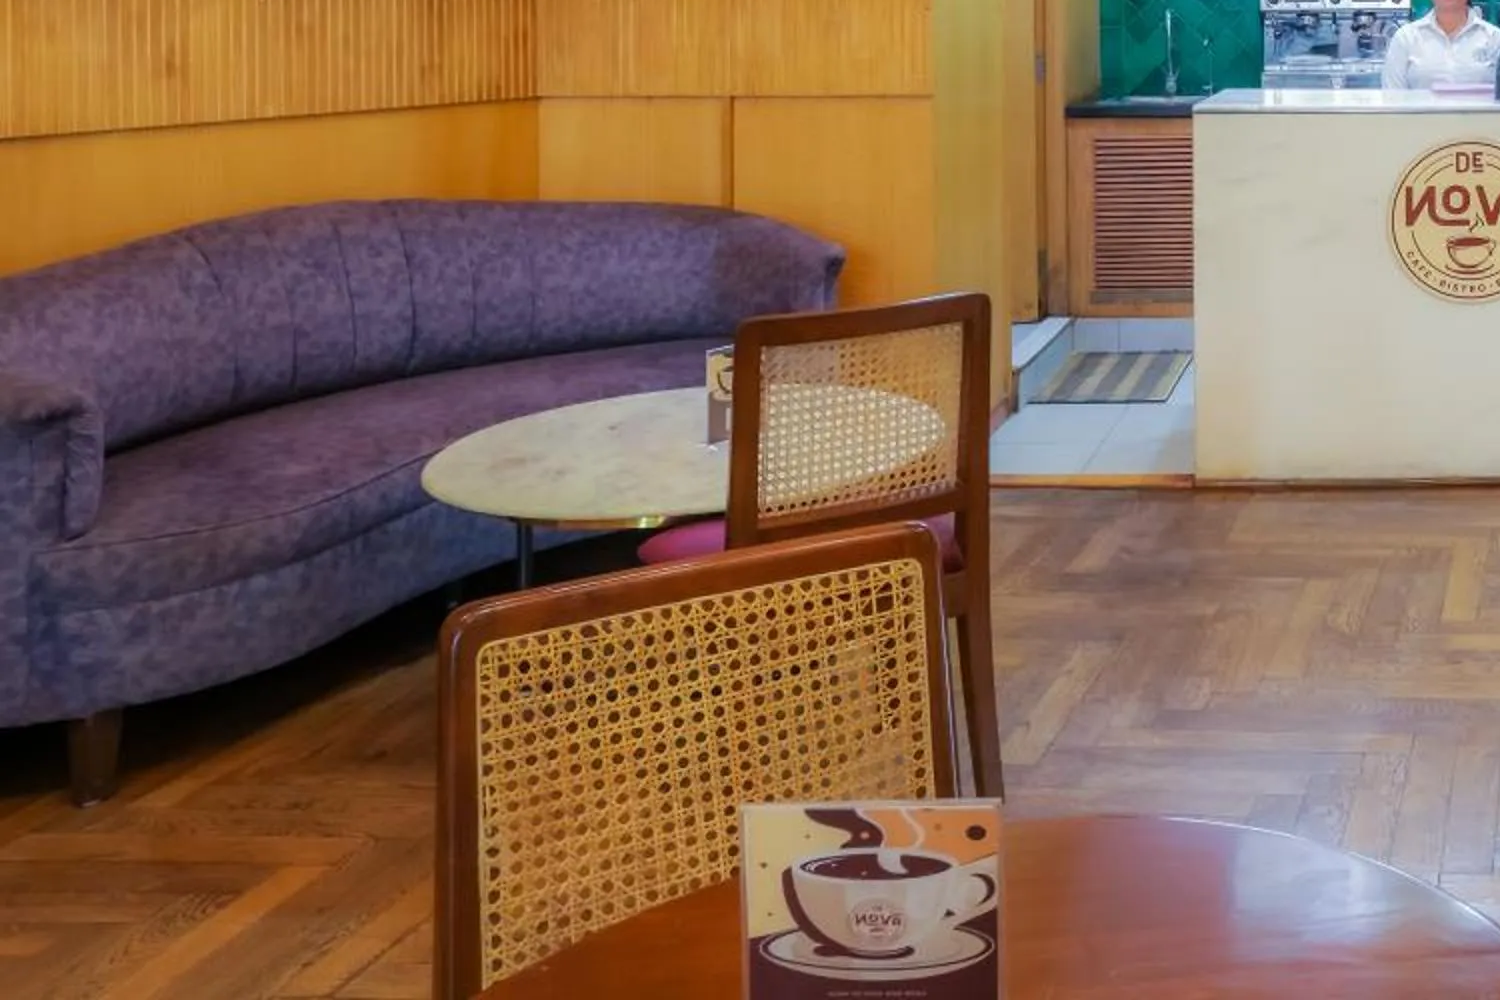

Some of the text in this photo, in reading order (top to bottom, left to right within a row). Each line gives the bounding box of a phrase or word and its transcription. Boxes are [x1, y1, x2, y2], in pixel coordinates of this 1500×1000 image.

[1455, 152, 1484, 173] DE
[1439, 280, 1487, 293] BISTRO
[854, 912, 904, 927] NOVA
